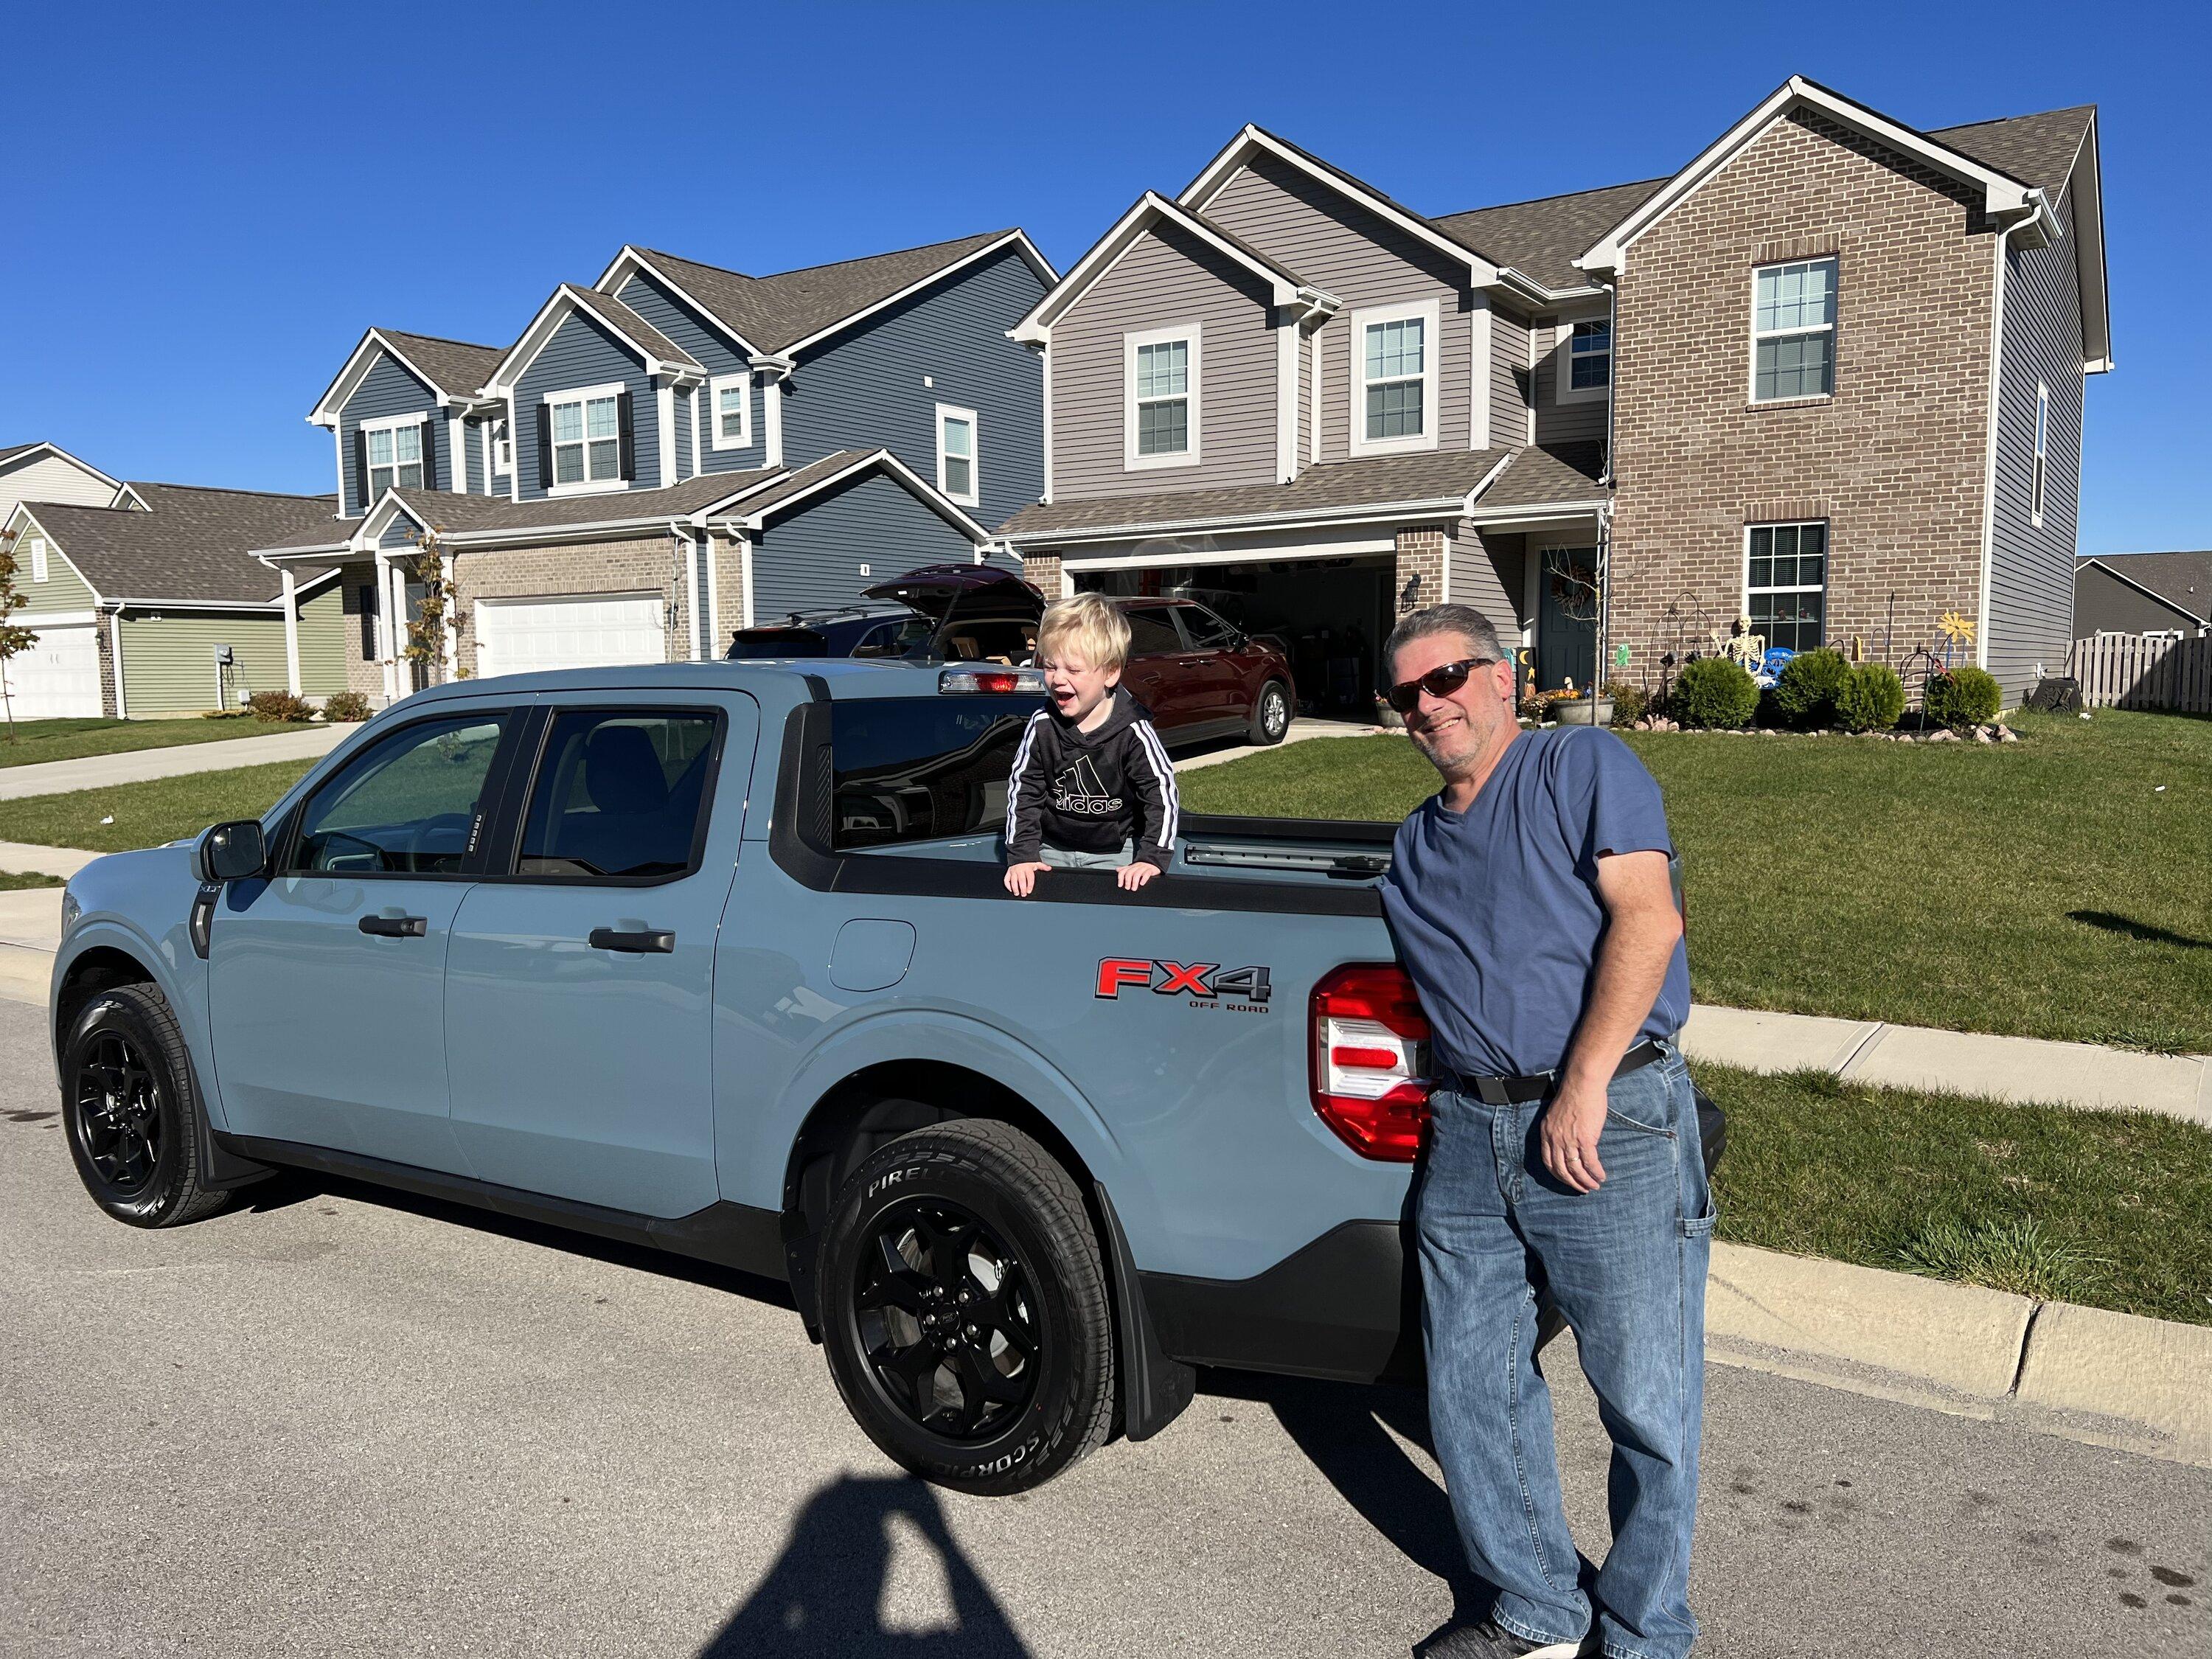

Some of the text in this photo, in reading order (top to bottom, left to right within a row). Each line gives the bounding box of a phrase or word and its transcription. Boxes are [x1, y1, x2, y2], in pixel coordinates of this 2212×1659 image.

[1094, 956, 1271, 1003] FX4
[1189, 1001, 1269, 1014] OFF ROAD
[869, 1166, 942, 1198] PIREL
[933, 1430, 1040, 1477] SCORPI
